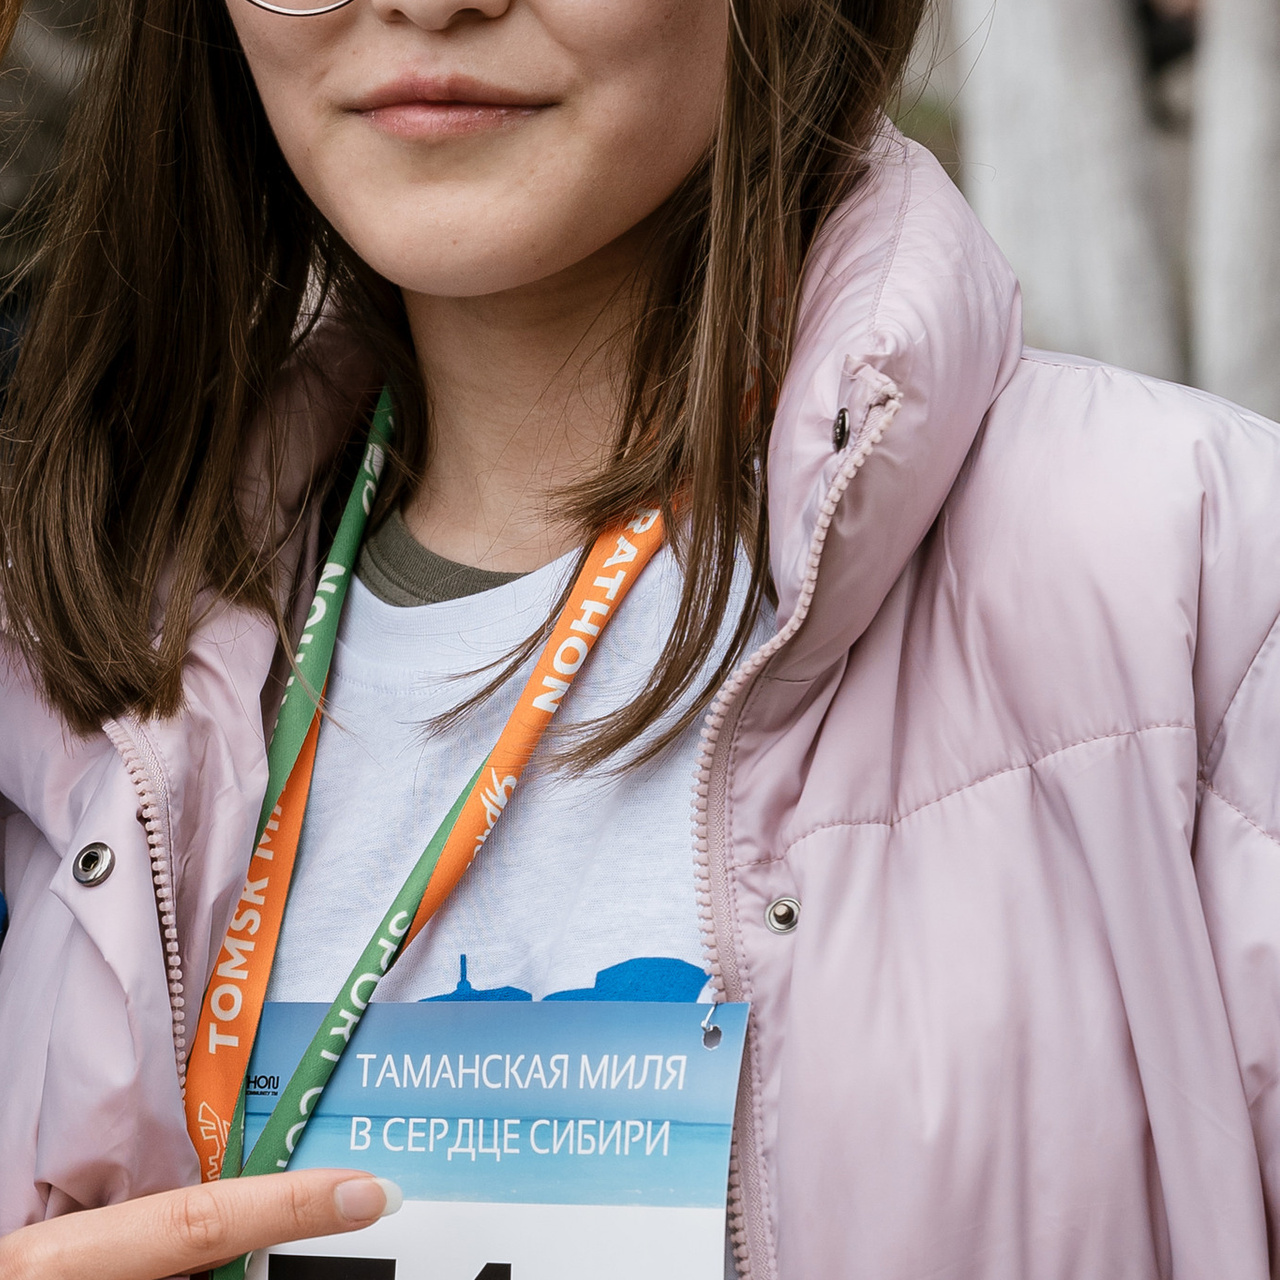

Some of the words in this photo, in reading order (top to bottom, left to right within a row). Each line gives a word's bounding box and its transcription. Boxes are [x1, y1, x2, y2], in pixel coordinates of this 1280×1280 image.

[532, 506, 661, 714] RATHON
[208, 876, 270, 1055] TOMSK
[356, 1053, 568, 1089] ТАМАНСКАЯ
[580, 1054, 687, 1090] МИЛЯ
[349, 1116, 371, 1151] В
[382, 1117, 520, 1161] СЕРДЦЕ
[529, 1119, 670, 1157] СИБИРИ
